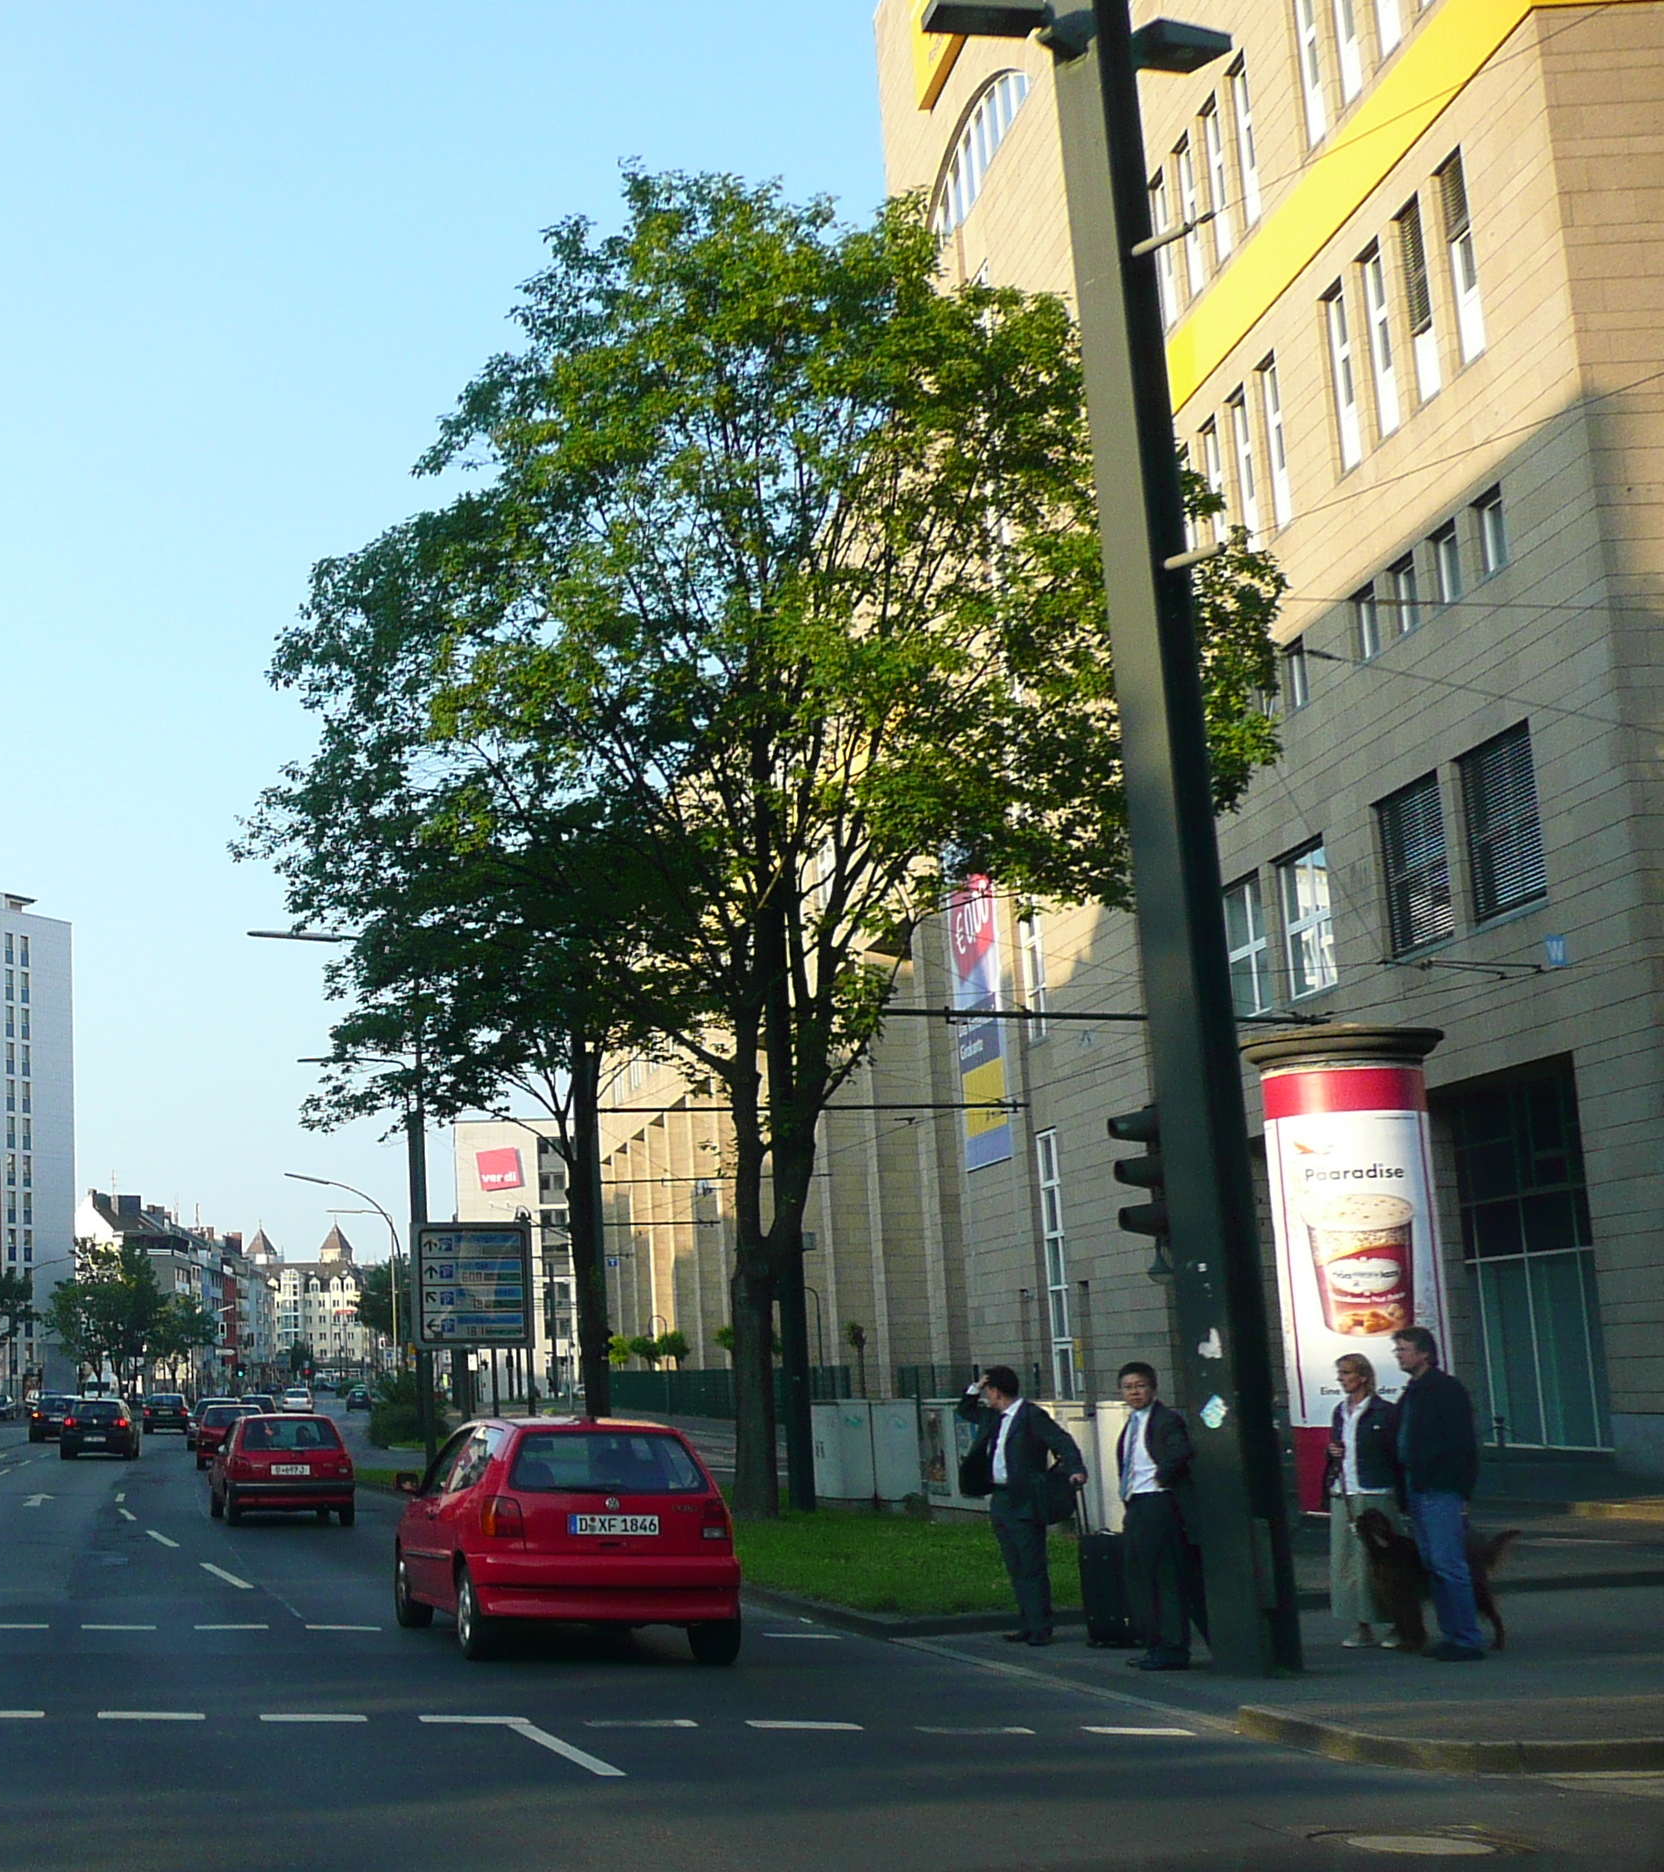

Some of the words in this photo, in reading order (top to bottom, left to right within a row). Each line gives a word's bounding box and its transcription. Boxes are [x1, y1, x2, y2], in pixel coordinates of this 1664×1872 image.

[1378, 1385, 1398, 1395] der
[579, 1518, 588, 1532] D
[598, 1518, 617, 1532] XF
[620, 1518, 657, 1532] 1846
